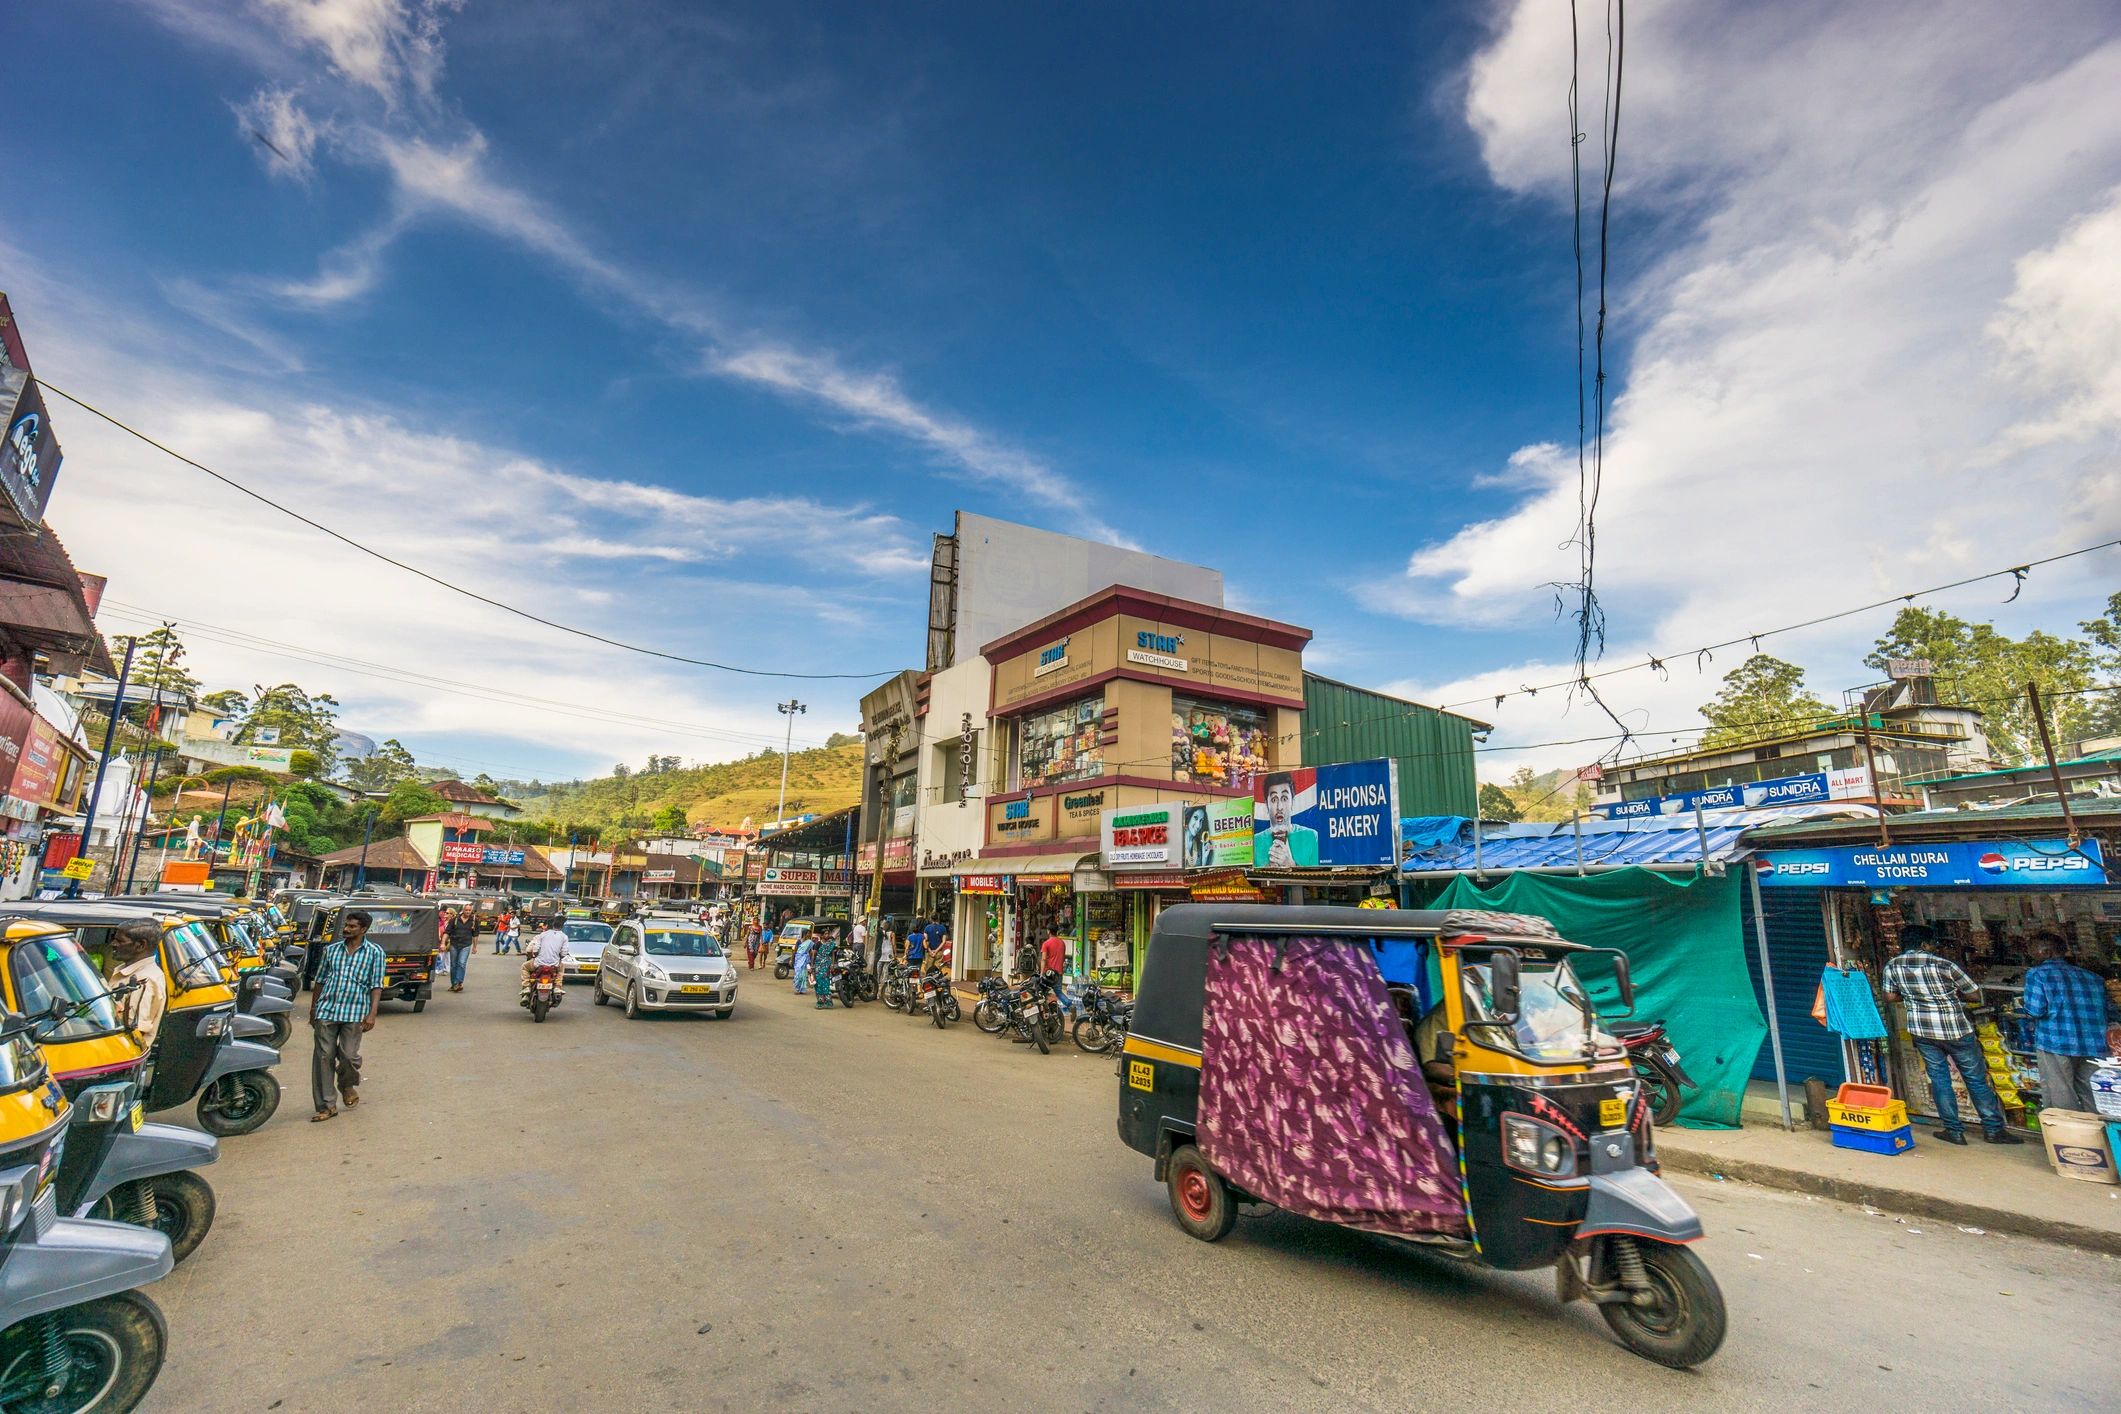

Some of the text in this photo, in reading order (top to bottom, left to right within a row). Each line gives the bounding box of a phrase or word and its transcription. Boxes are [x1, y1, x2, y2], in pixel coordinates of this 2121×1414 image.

[1137, 631, 1177, 654] STAR
[1040, 644, 1065, 667] STAR
[1192, 667, 1214, 678] SPORTS
[1215, 672, 1234, 682] GOODS
[1236, 675, 1258, 686] SCHOOL
[1831, 776, 1864, 788] ALL MART
[1769, 781, 1821, 798] SUNIDRA
[1064, 791, 1104, 810] Greenleaf
[1319, 783, 1387, 811] ALPHONSA
[1692, 792, 1733, 807] SUNIDRA
[1005, 800, 1029, 820] STAR
[1069, 811, 1078, 819] TEA
[1083, 808, 1100, 817] SPICES
[1616, 803, 1650, 816] SUNIDRA
[1018, 819, 1040, 830] HOUSE
[1214, 814, 1251, 832] BEEMA
[1329, 814, 1380, 838] BAKERY
[1853, 852, 1949, 866] CHELLAM DURAI
[2013, 856, 2090, 871] PEPSI
[67, 865, 79, 873] CA
[1777, 862, 1830, 875] PEPSI
[1876, 865, 1928, 878] STORES
[780, 870, 817, 882] SUPER
[970, 877, 994, 888] MOBILE
[1212, 886, 1227, 895] GOLD
[1841, 1112, 1872, 1125] ARDF
